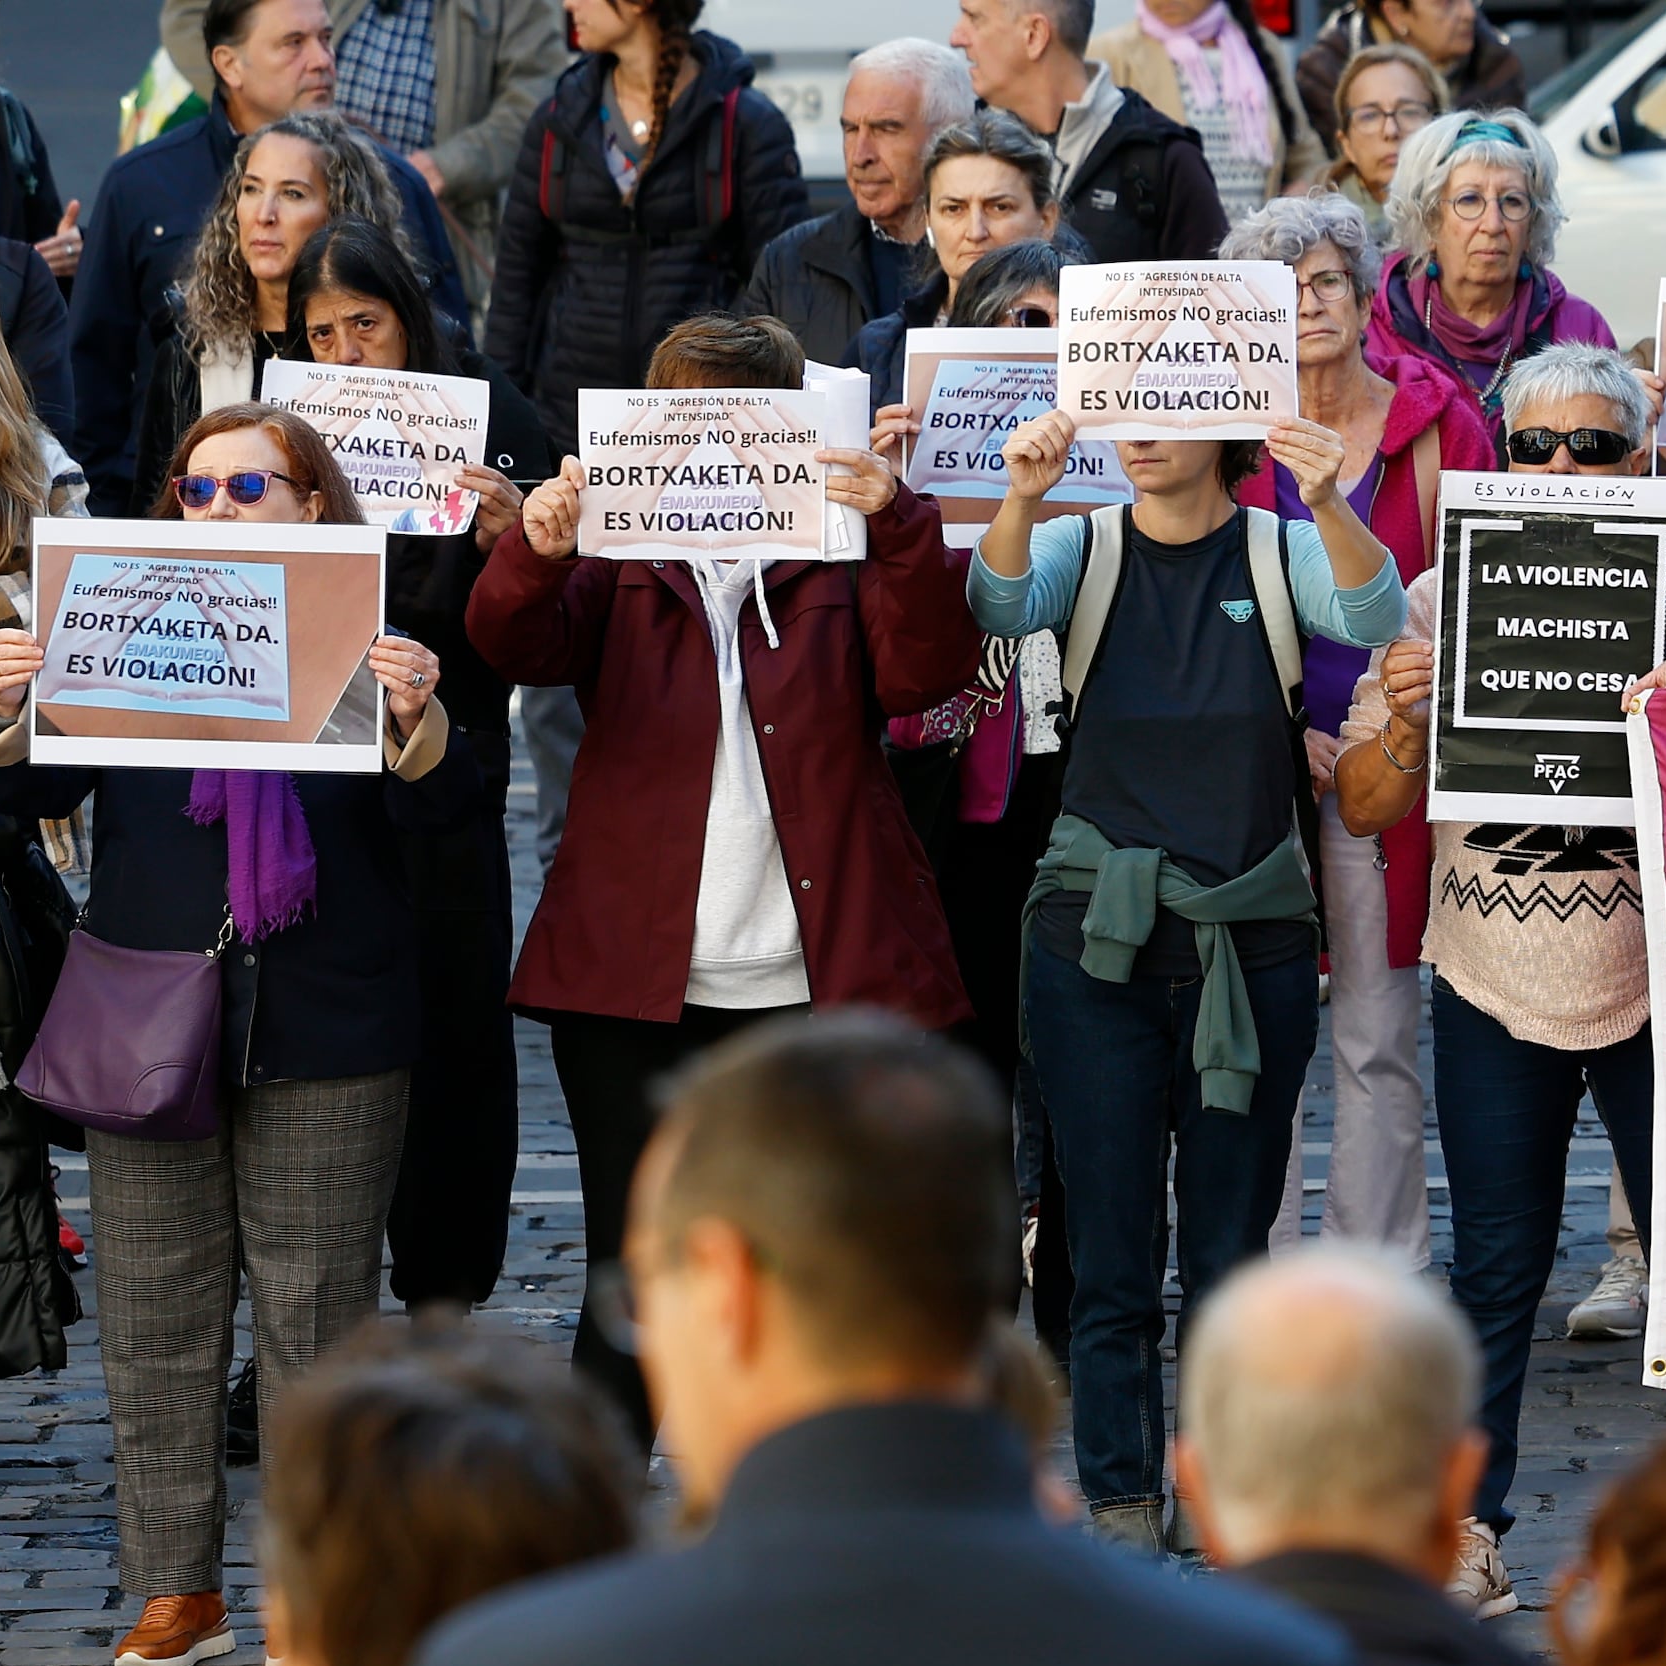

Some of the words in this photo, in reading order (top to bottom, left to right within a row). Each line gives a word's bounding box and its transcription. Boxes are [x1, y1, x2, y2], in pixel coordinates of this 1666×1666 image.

[1106, 273, 1120, 281] NO
[1202, 273, 1214, 281] DE
[1217, 274, 1242, 282] ALTA
[1071, 306, 1176, 321] Eufemismos
[1183, 307, 1210, 320] NO
[1216, 308, 1286, 324] gracias!!
[1069, 342, 1240, 362] BORTXAKETA
[1249, 343, 1289, 363] DA.
[307, 372, 323, 381] NO
[398, 381, 410, 389] DE
[415, 382, 438, 392] ALTA
[627, 398, 644, 406] NO
[648, 398, 659, 406] ES
[728, 398, 740, 406] DE
[744, 398, 770, 406] ALTA
[939, 387, 1028, 400] Eufemismos
[1032, 391, 1055, 402] NO
[1081, 391, 1107, 410] ES
[1115, 385, 1269, 410] VIOLACIÓN!
[376, 408, 402, 422] NO
[407, 413, 477, 431] gracias!!
[931, 413, 1037, 431] BORTXA
[318, 432, 426, 460] TXAKETA
[435, 444, 473, 464] DA.
[590, 431, 701, 446] Eufemismos
[707, 431, 735, 444] NO
[741, 430, 816, 447] gracias!!
[934, 451, 959, 468] ES
[589, 465, 764, 486] BORTXAKETA
[774, 464, 817, 485] DA.
[354, 473, 448, 501] LACIÓN!
[1474, 483, 1494, 496] ES
[604, 512, 631, 530] ES
[640, 506, 794, 531] VIOLACIÓN!
[1482, 564, 1511, 585] LA
[1517, 565, 1648, 588] VIOLENCIA
[73, 584, 171, 601] Eufemismos
[177, 592, 202, 603] NO
[208, 595, 277, 609] gracias!!
[63, 611, 227, 640] BORTXAKETA
[236, 624, 279, 644] DA.
[1497, 618, 1629, 640] MACHISTA
[66, 654, 95, 674] ES
[102, 657, 256, 688] VIOLACIÓN!
[1481, 670, 1529, 691] QUE
[1535, 671, 1572, 691] NO
[1577, 672, 1639, 693] CESA
[1534, 764, 1580, 779] PFAC
